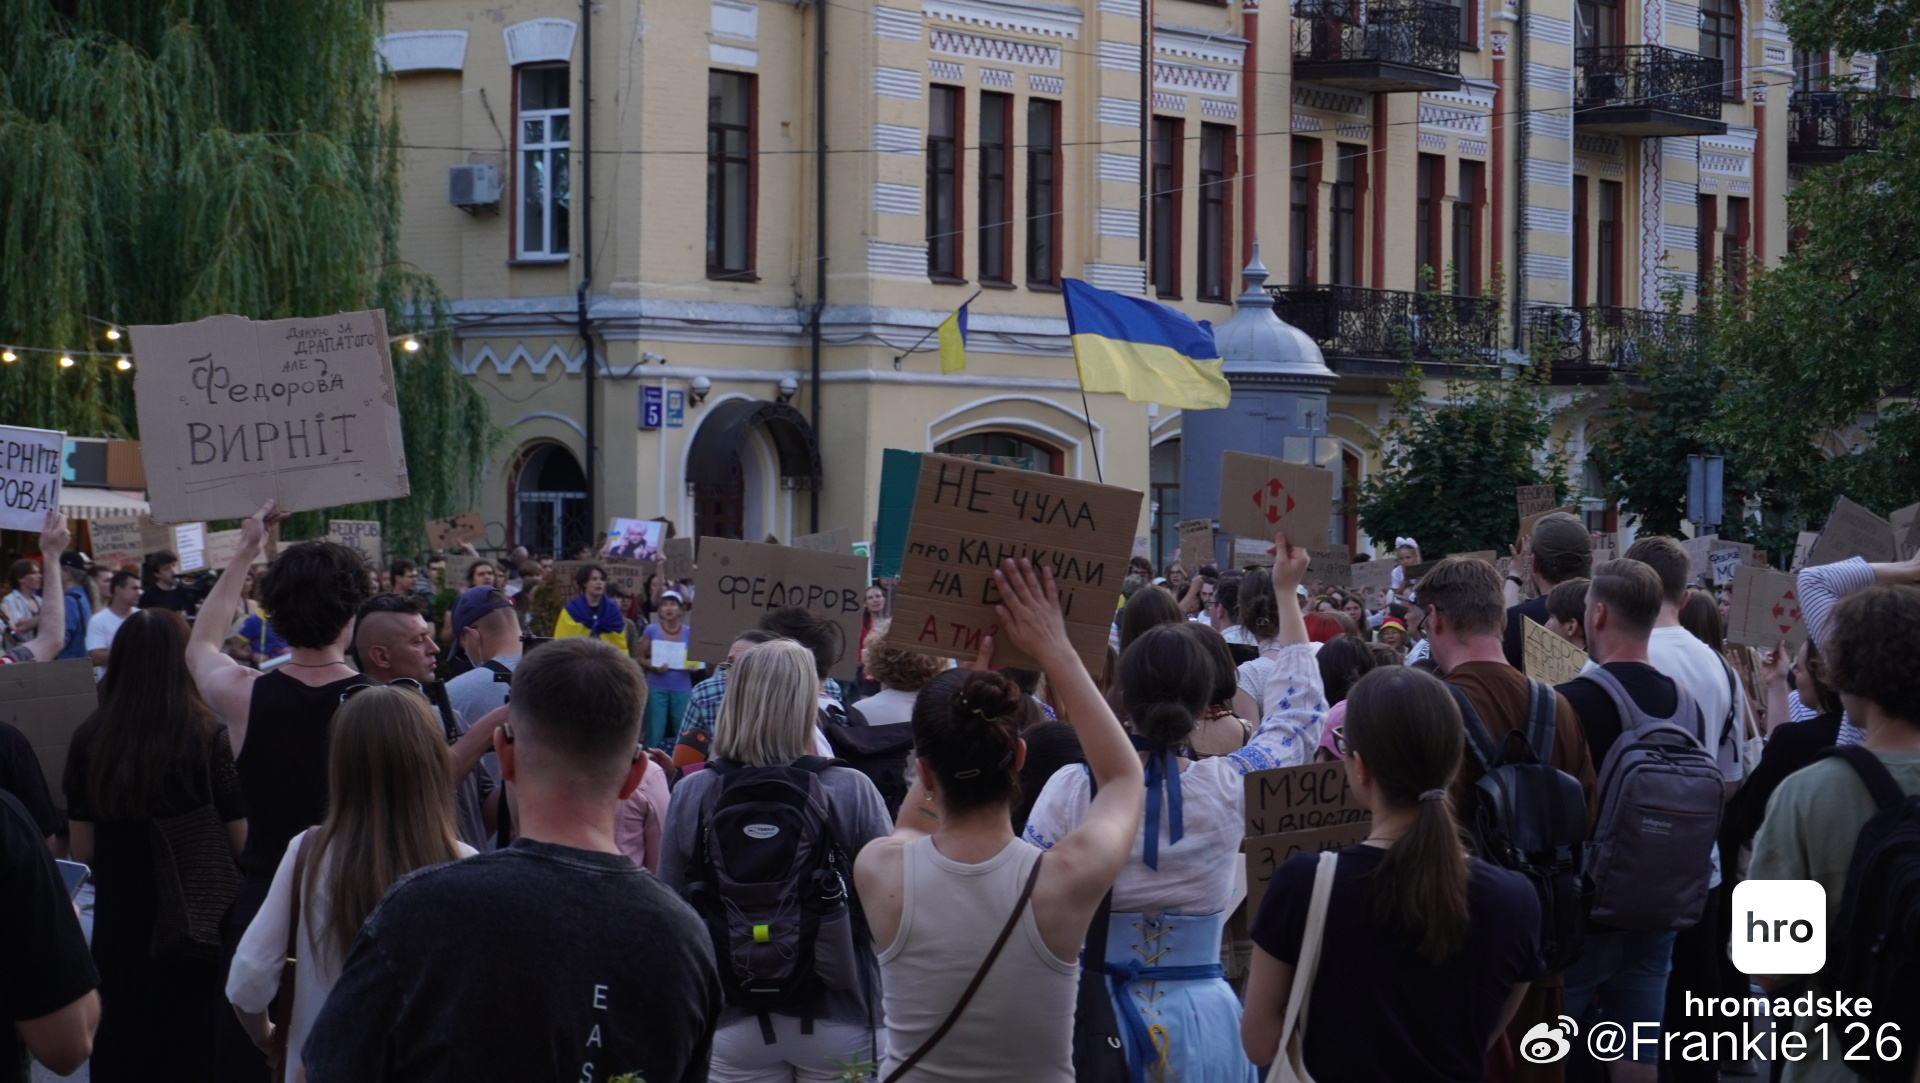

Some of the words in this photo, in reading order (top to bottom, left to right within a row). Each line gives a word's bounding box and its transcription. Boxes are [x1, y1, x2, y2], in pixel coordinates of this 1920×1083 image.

[294, 333, 376, 355] ДРАПАТОГО
[281, 360, 308, 373] АЛЕ
[648, 406, 659, 425] 5
[934, 462, 996, 514] НЕ
[1011, 489, 1096, 532] ЧУЛА
[718, 575, 861, 613] ФЕДОРОВ
[928, 569, 963, 598] НА
[918, 614, 939, 643] А
